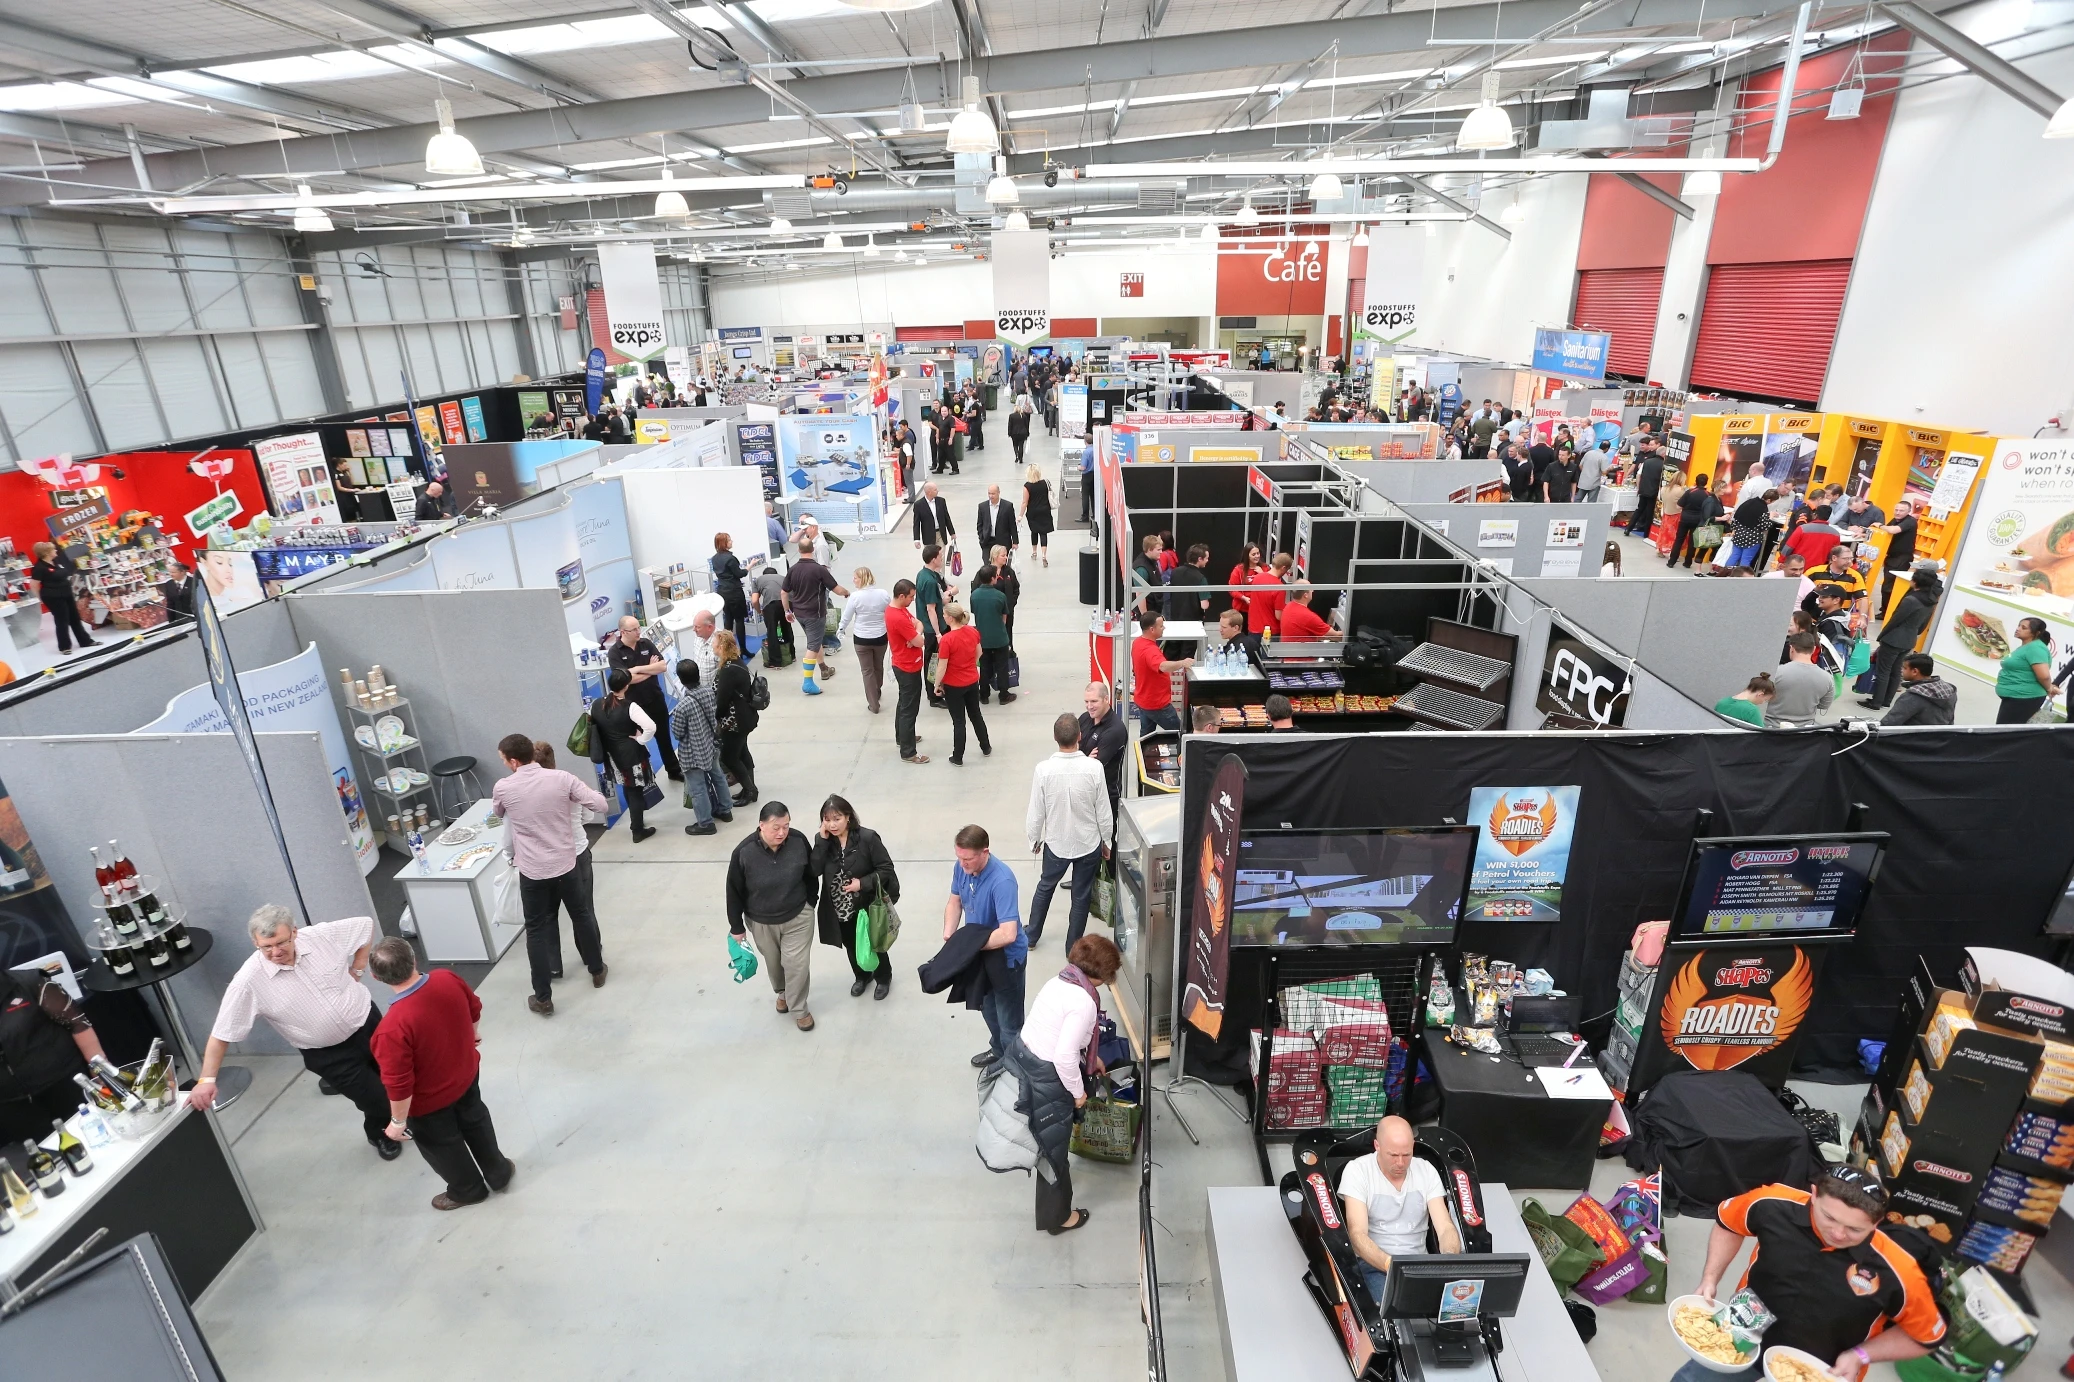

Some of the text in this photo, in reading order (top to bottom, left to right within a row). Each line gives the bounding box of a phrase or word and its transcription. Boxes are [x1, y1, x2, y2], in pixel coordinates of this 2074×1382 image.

[1263, 251, 1321, 282] Café
[1121, 273, 1143, 283] EXIT
[559, 297, 574, 310] EXIT
[1562, 339, 1602, 361] Sanitarium
[1536, 408, 1562, 418] Blistex
[1590, 408, 1618, 418] Blistex
[2029, 449, 2067, 460] won't
[2024, 464, 2062, 475] won't
[2020, 480, 2056, 488] when
[61, 506, 98, 527] FROZEN
[1995, 511, 2024, 524] QUALITY
[1989, 528, 2022, 544] GUARANTEE
[465, 572, 495, 589] Tuna
[262, 674, 320, 703] PACKAGING
[1550, 648, 1614, 724] FPG
[250, 710, 264, 719] IN
[268, 700, 295, 712] NEW
[1500, 820, 1544, 835] ROADIES
[1510, 861, 1540, 869] $1,000
[1746, 852, 1794, 862] ARNOTT'S
[1483, 870, 1510, 878] Petrol
[2021, 999, 2060, 1016] ARNOTT'S
[1680, 1002, 1779, 1034] ROADIES
[1994, 1010, 2066, 1034] for every occasion
[2004, 1008, 2062, 1026] Tasty crackers
[1674, 1036, 1700, 1044] SERIOUSLY
[1963, 1048, 2024, 1066] Tasty crackers
[1967, 1052, 1991, 1064] every
[1992, 1059, 2028, 1073] occasion
[1926, 1164, 1966, 1181] ARNOTT'S
[1456, 1174, 1474, 1214] ARNOTT'S
[1903, 1189, 1958, 1210] Tasty crackers
[1316, 1184, 1336, 1224] ARNOTT'S
[1907, 1195, 1927, 1206] every
[1929, 1202, 1962, 1216] occasion
